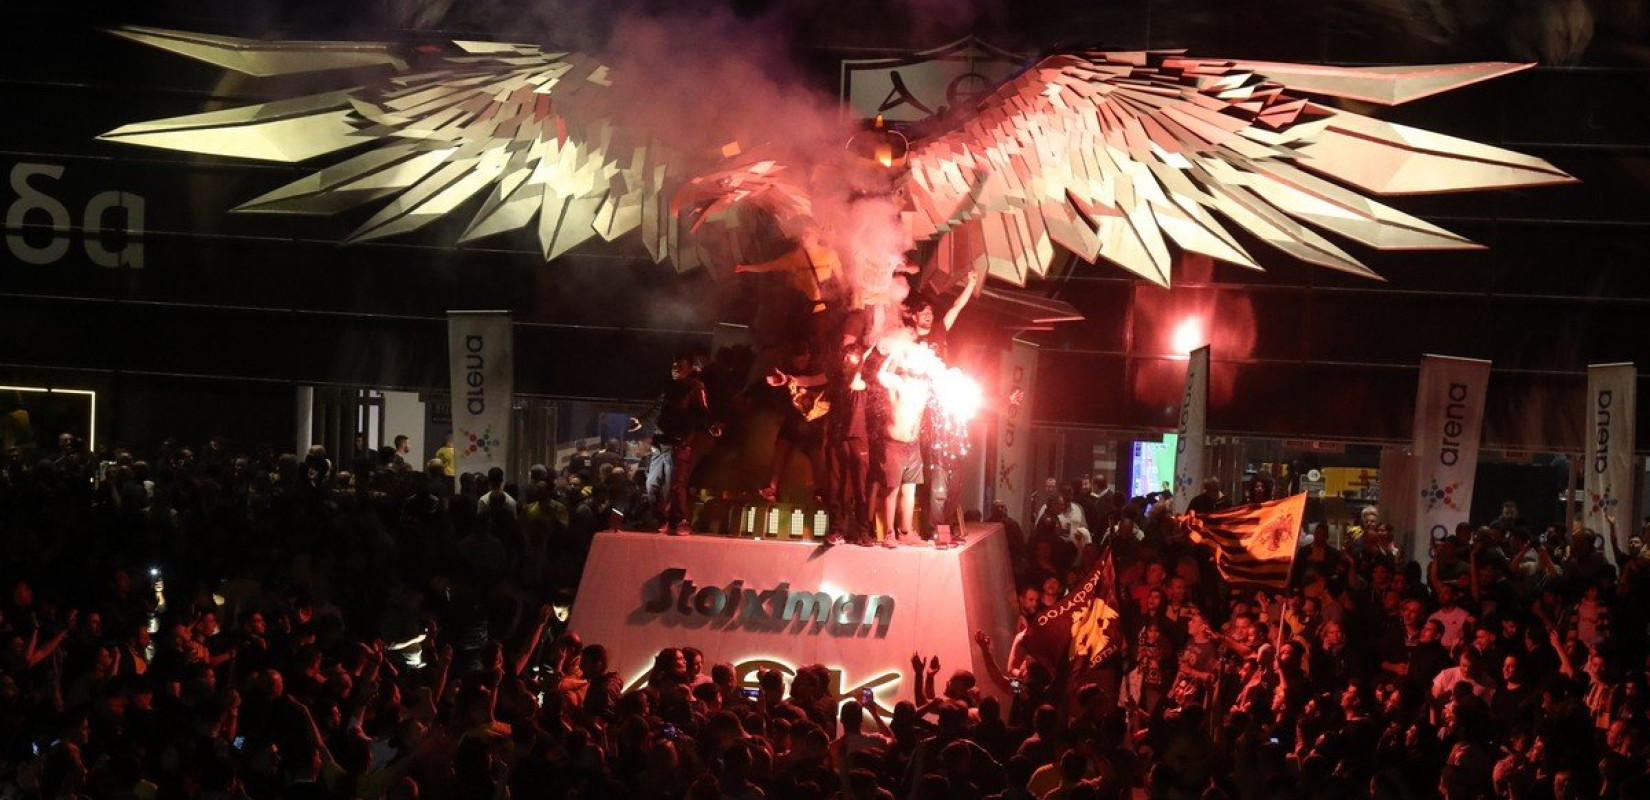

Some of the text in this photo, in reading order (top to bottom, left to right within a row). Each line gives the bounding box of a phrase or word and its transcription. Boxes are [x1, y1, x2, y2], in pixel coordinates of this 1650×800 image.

[466, 335, 485, 415] arena
[1440, 382, 1468, 466] arena
[1595, 389, 1613, 474] arena
[643, 568, 896, 630] Stoiximan
